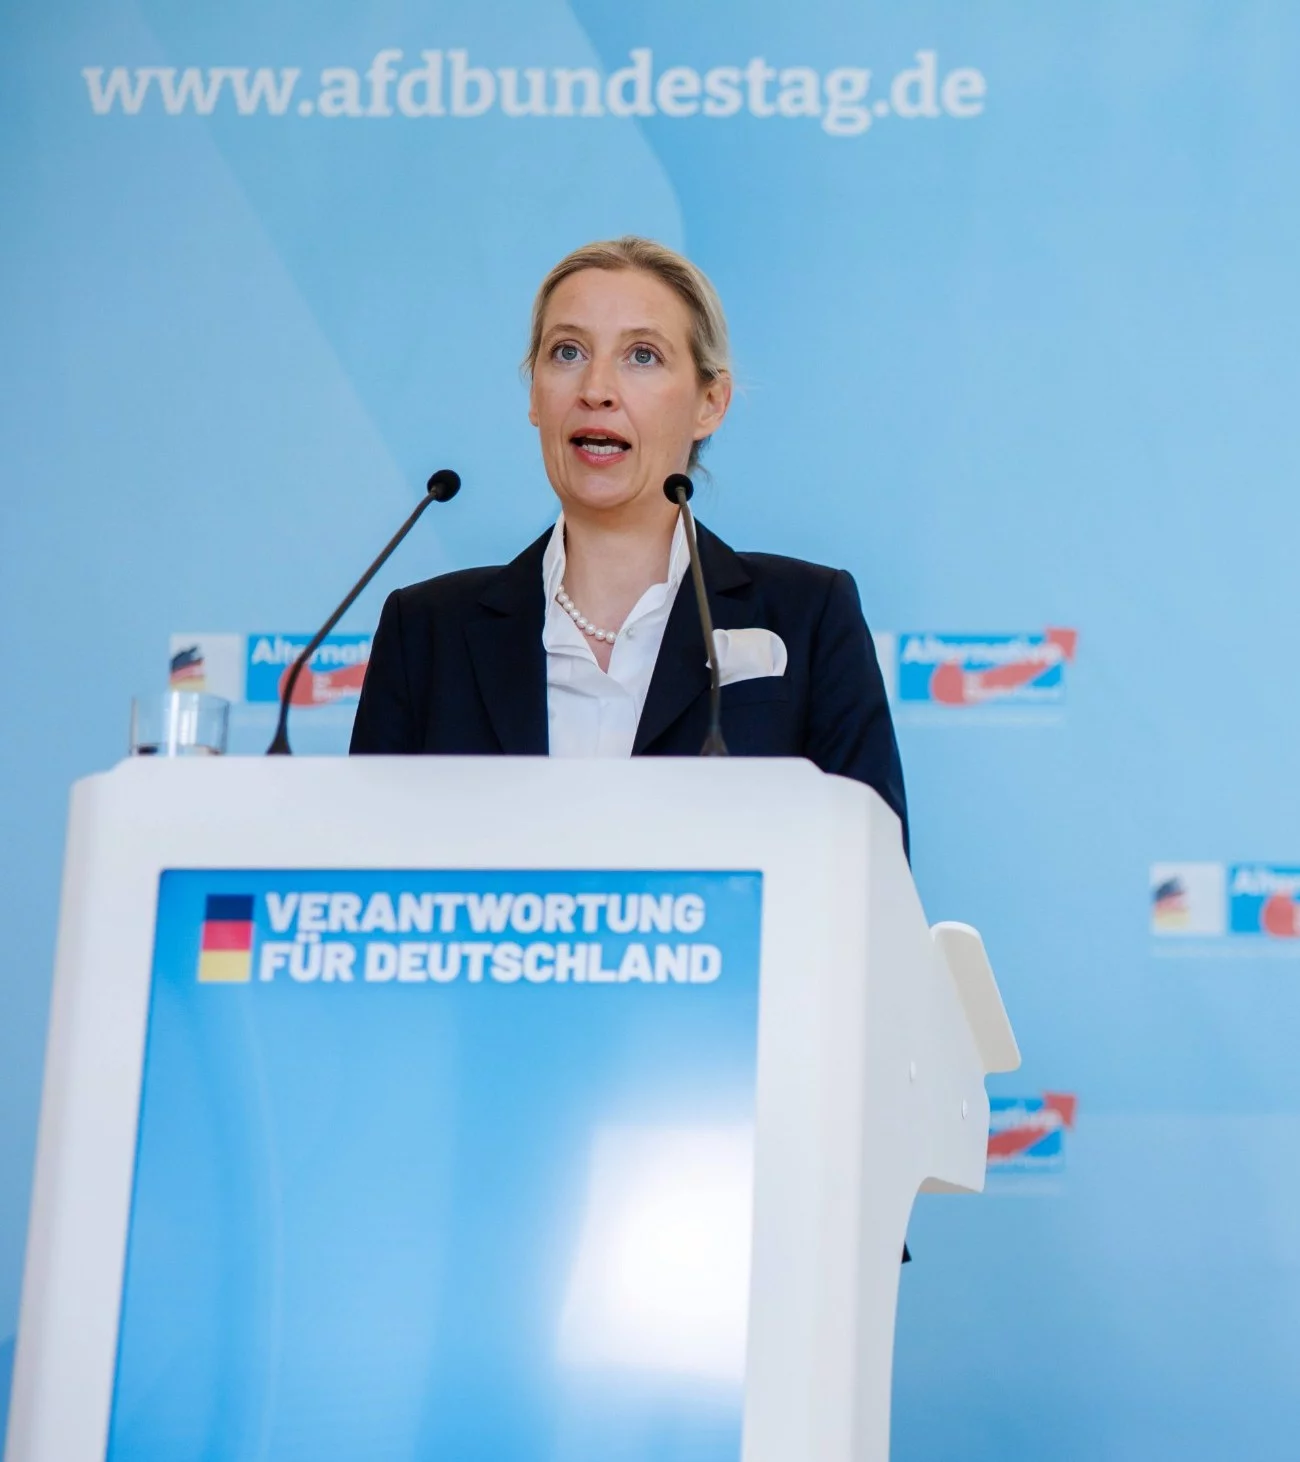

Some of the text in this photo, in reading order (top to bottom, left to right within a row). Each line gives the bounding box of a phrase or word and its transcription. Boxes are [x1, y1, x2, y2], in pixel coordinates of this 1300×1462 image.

[82, 47, 988, 137] www.afdbundestag.de
[265, 891, 706, 934] VERANTWORTUNG
[258, 933, 723, 983] FÜR DEUTSCHLAND
